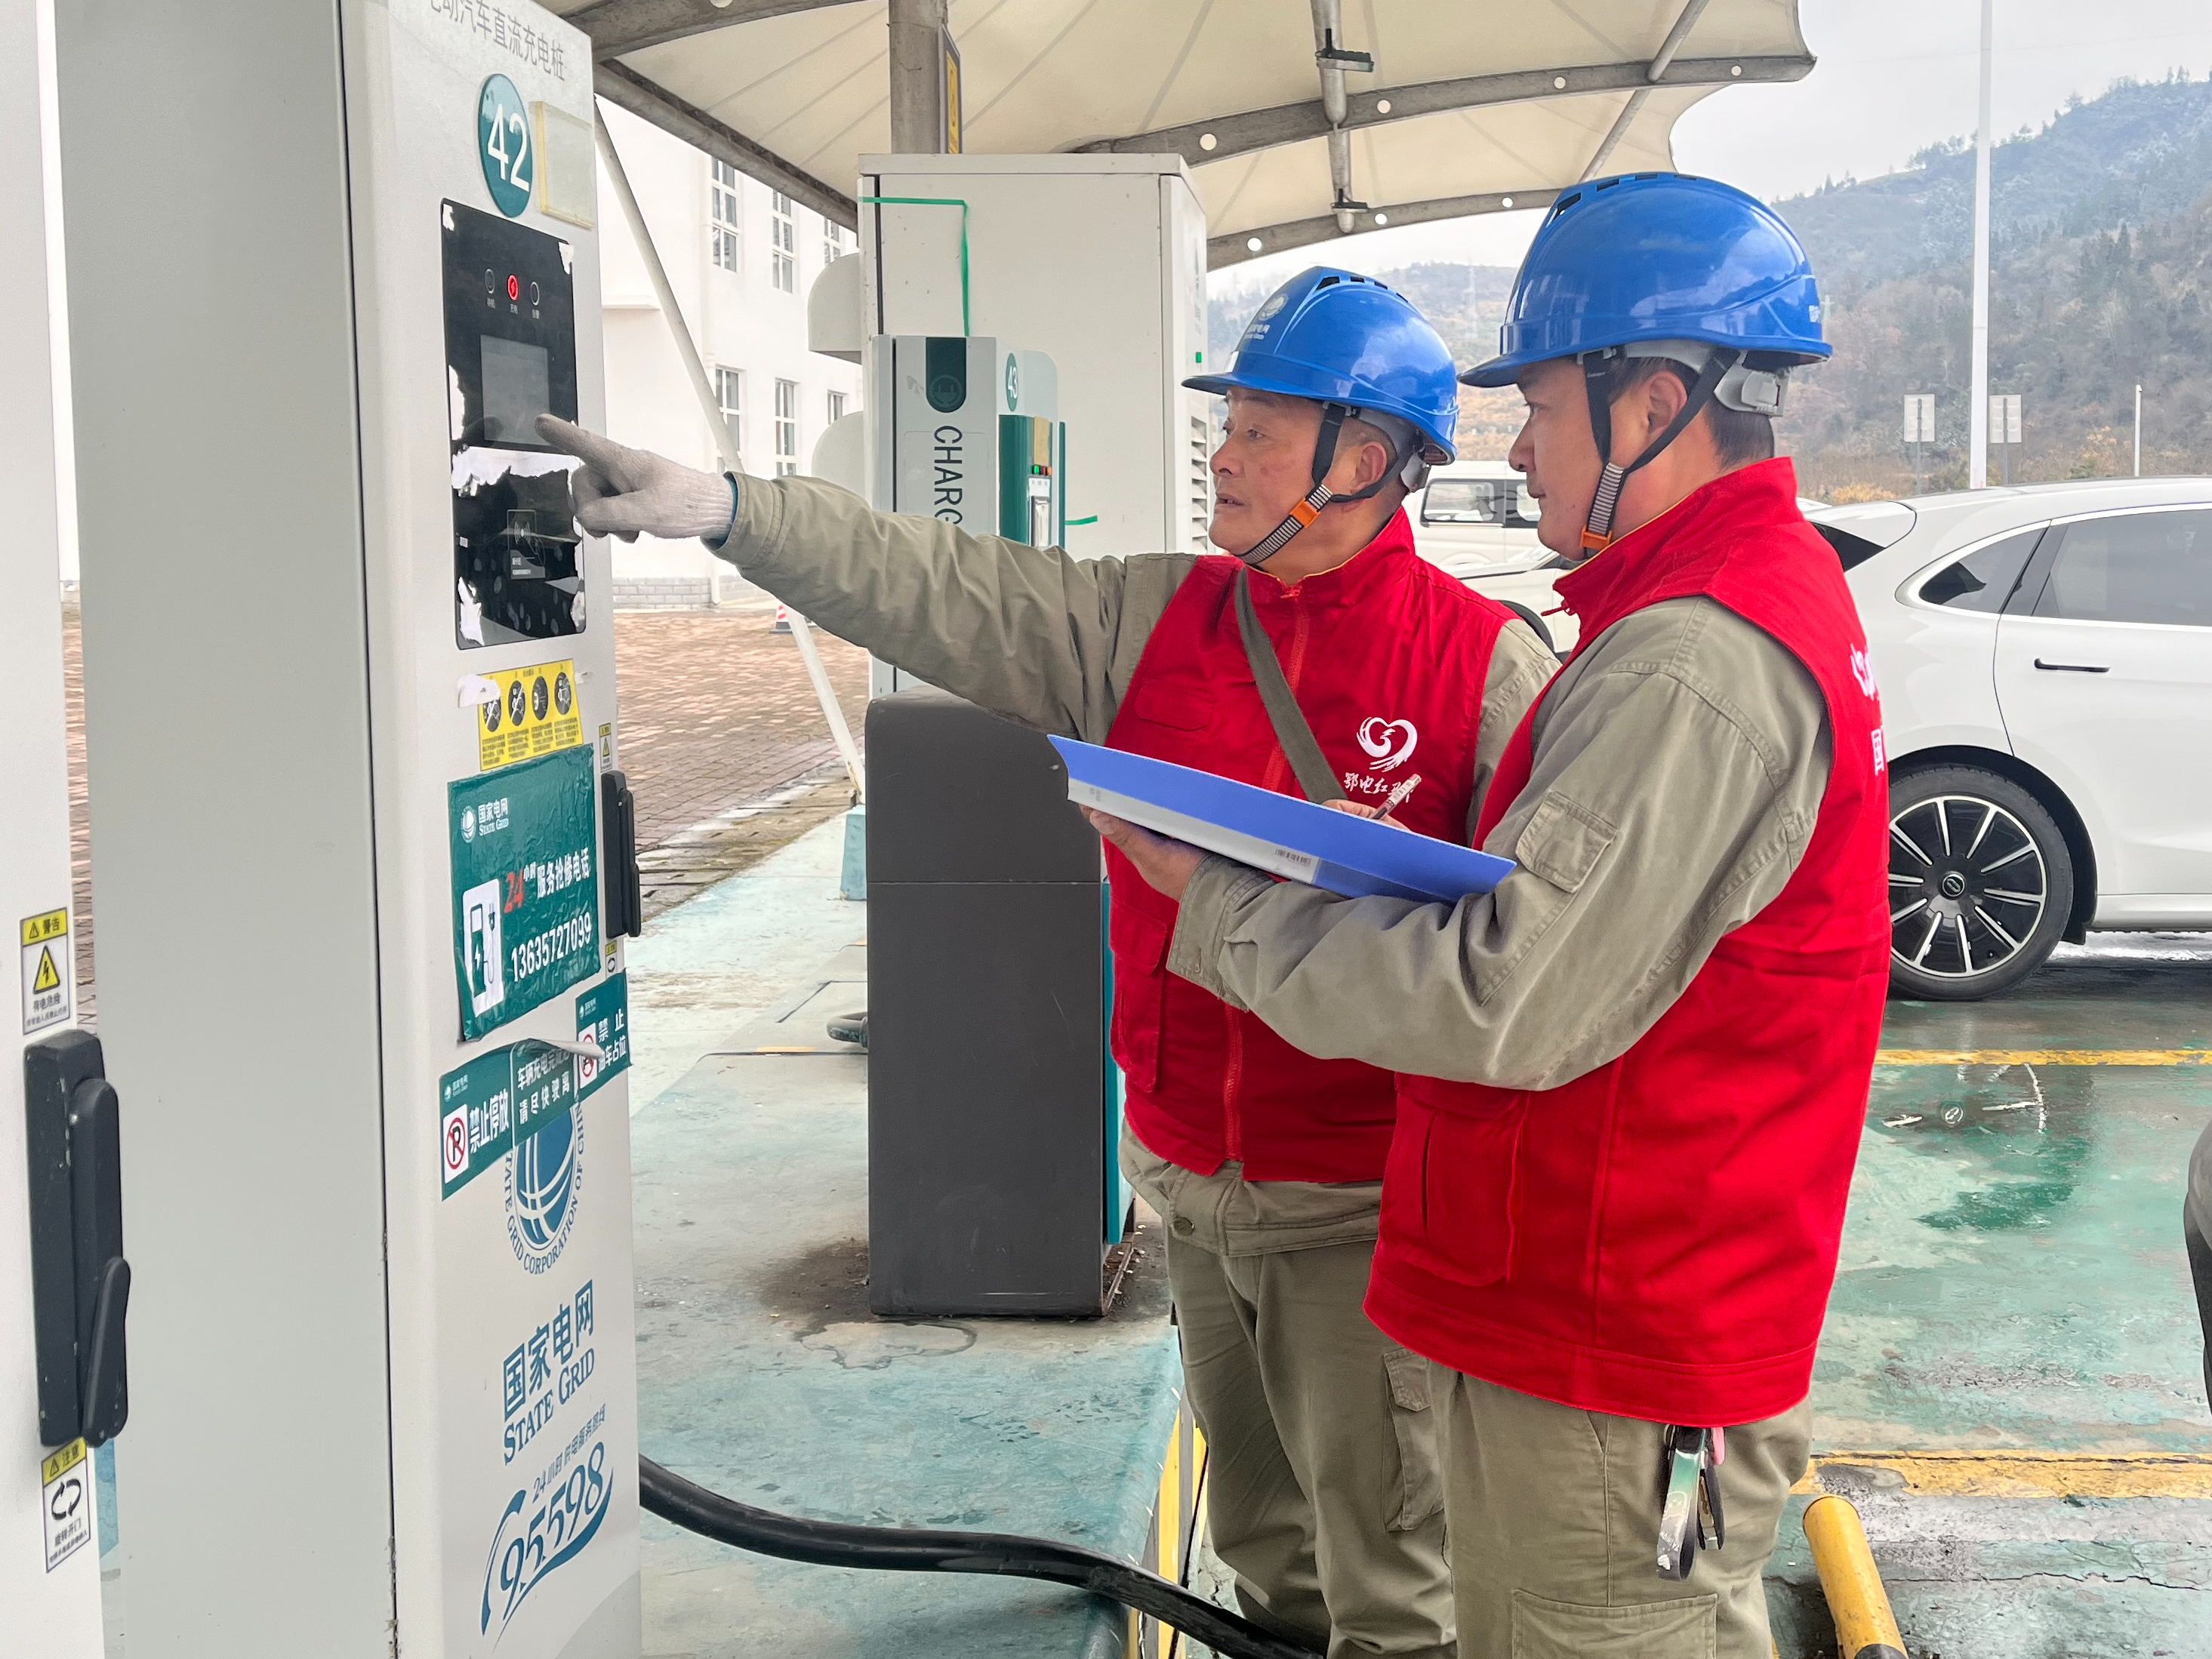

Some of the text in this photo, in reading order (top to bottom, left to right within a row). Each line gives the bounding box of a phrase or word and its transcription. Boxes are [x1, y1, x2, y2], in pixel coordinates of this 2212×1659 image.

[488, 103, 530, 192] 42
[1008, 365, 1018, 399] 43
[478, 797, 508, 824] 国家电网
[42, 917, 60, 936] 警告
[511, 911, 592, 982] 13635727099
[469, 1088, 510, 1154] 禁止停放
[575, 1101, 585, 1156] CHIN
[504, 1152, 513, 1212] TATE
[507, 1214, 525, 1261] GRID
[523, 1195, 579, 1276] CORPORATION
[503, 1279, 593, 1423] 国家电网
[504, 1347, 595, 1467] STATE GRID
[500, 1441, 605, 1621] 95598
